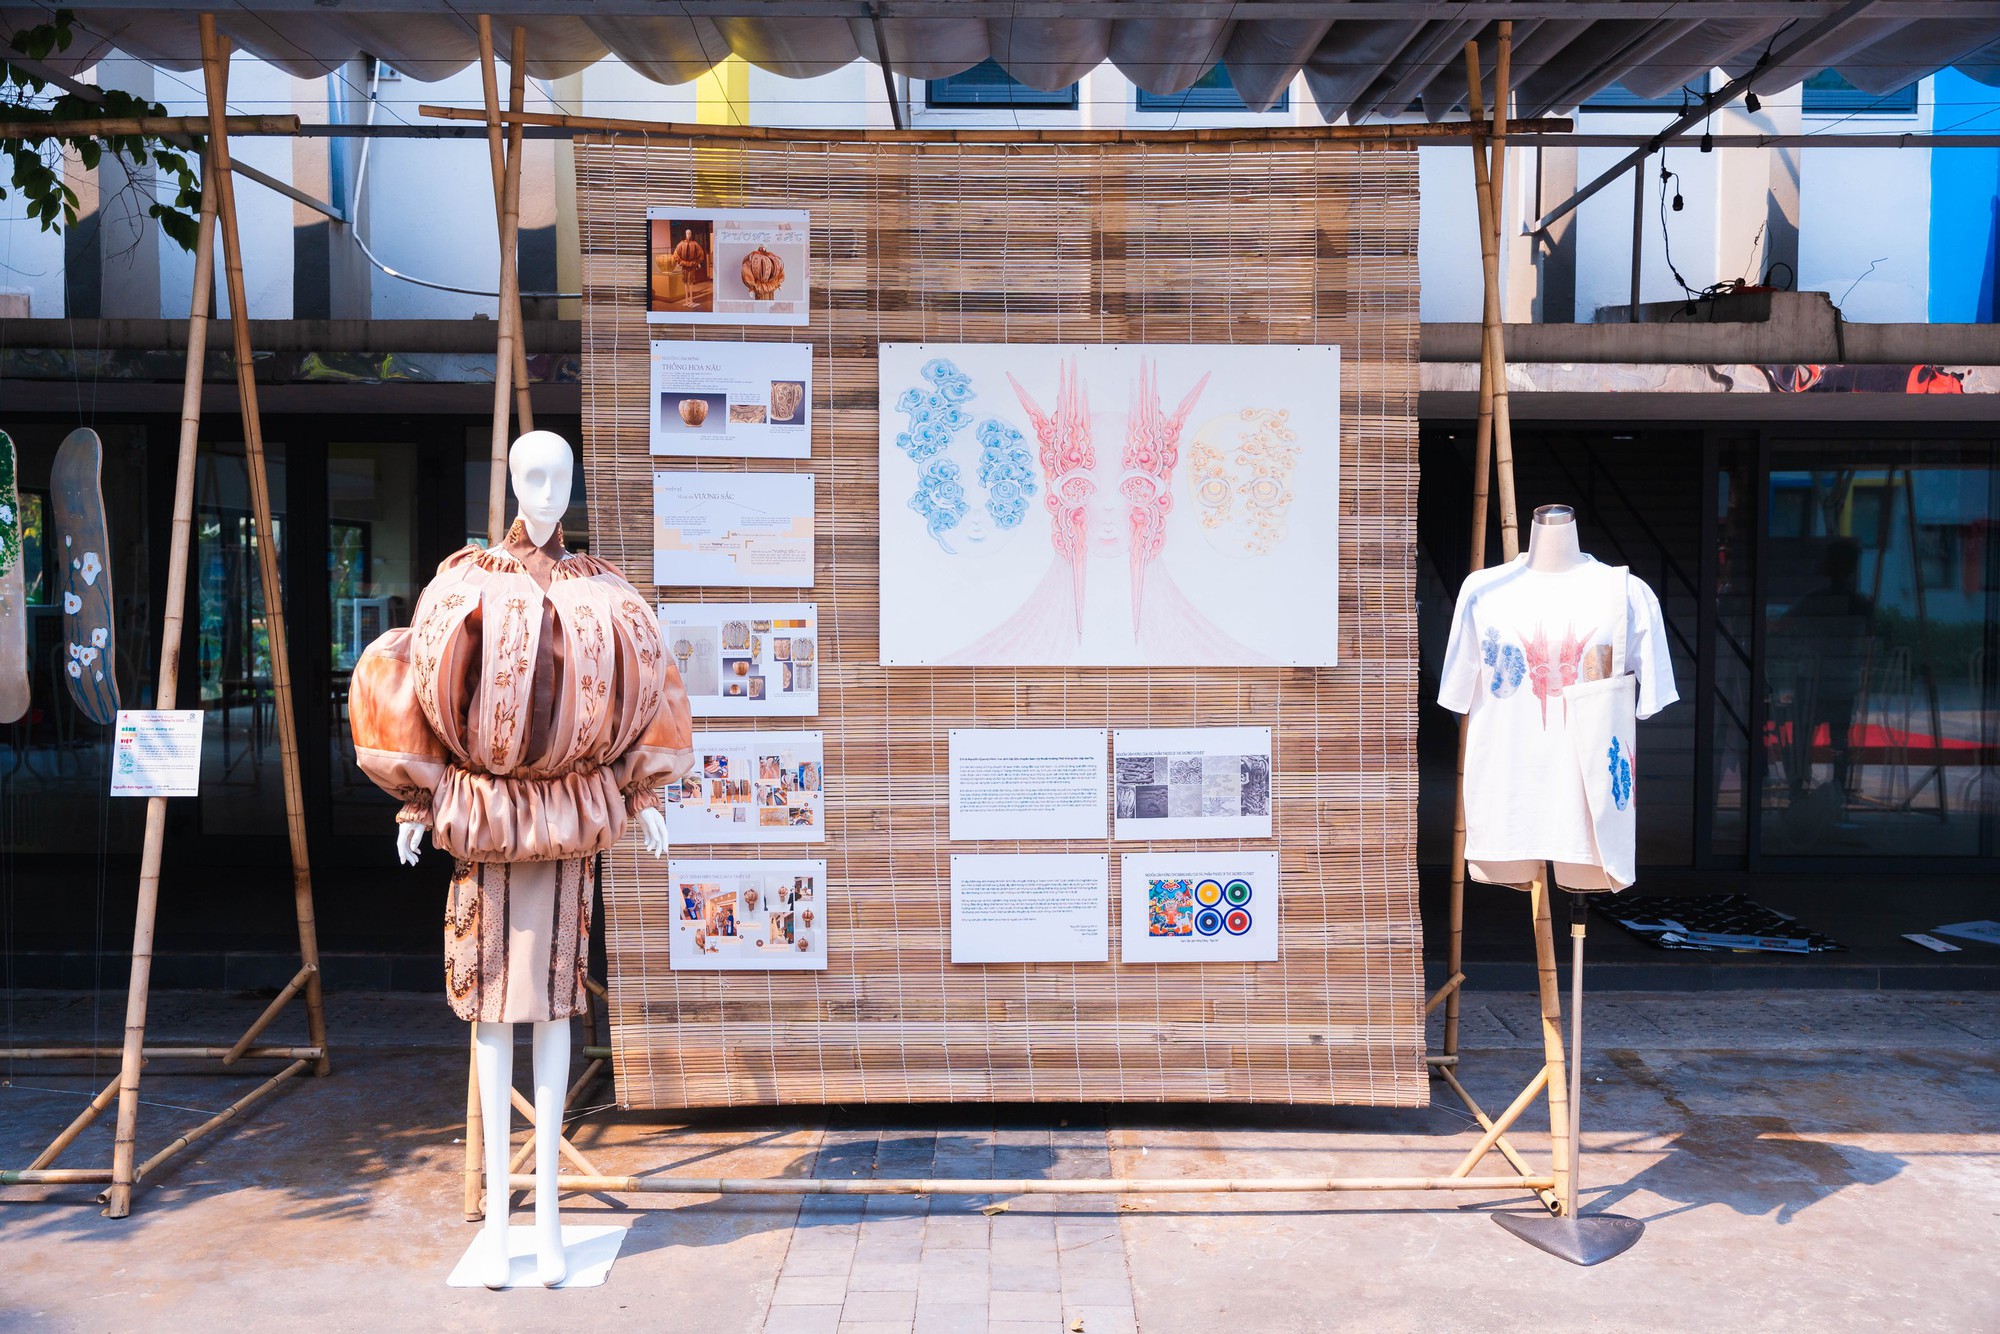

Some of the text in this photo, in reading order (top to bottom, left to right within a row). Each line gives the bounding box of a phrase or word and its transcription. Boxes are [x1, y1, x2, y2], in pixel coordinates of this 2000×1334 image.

[662, 362, 687, 370] THỐNG
[706, 364, 721, 372] NÂU
[720, 491, 735, 500] SẮC
